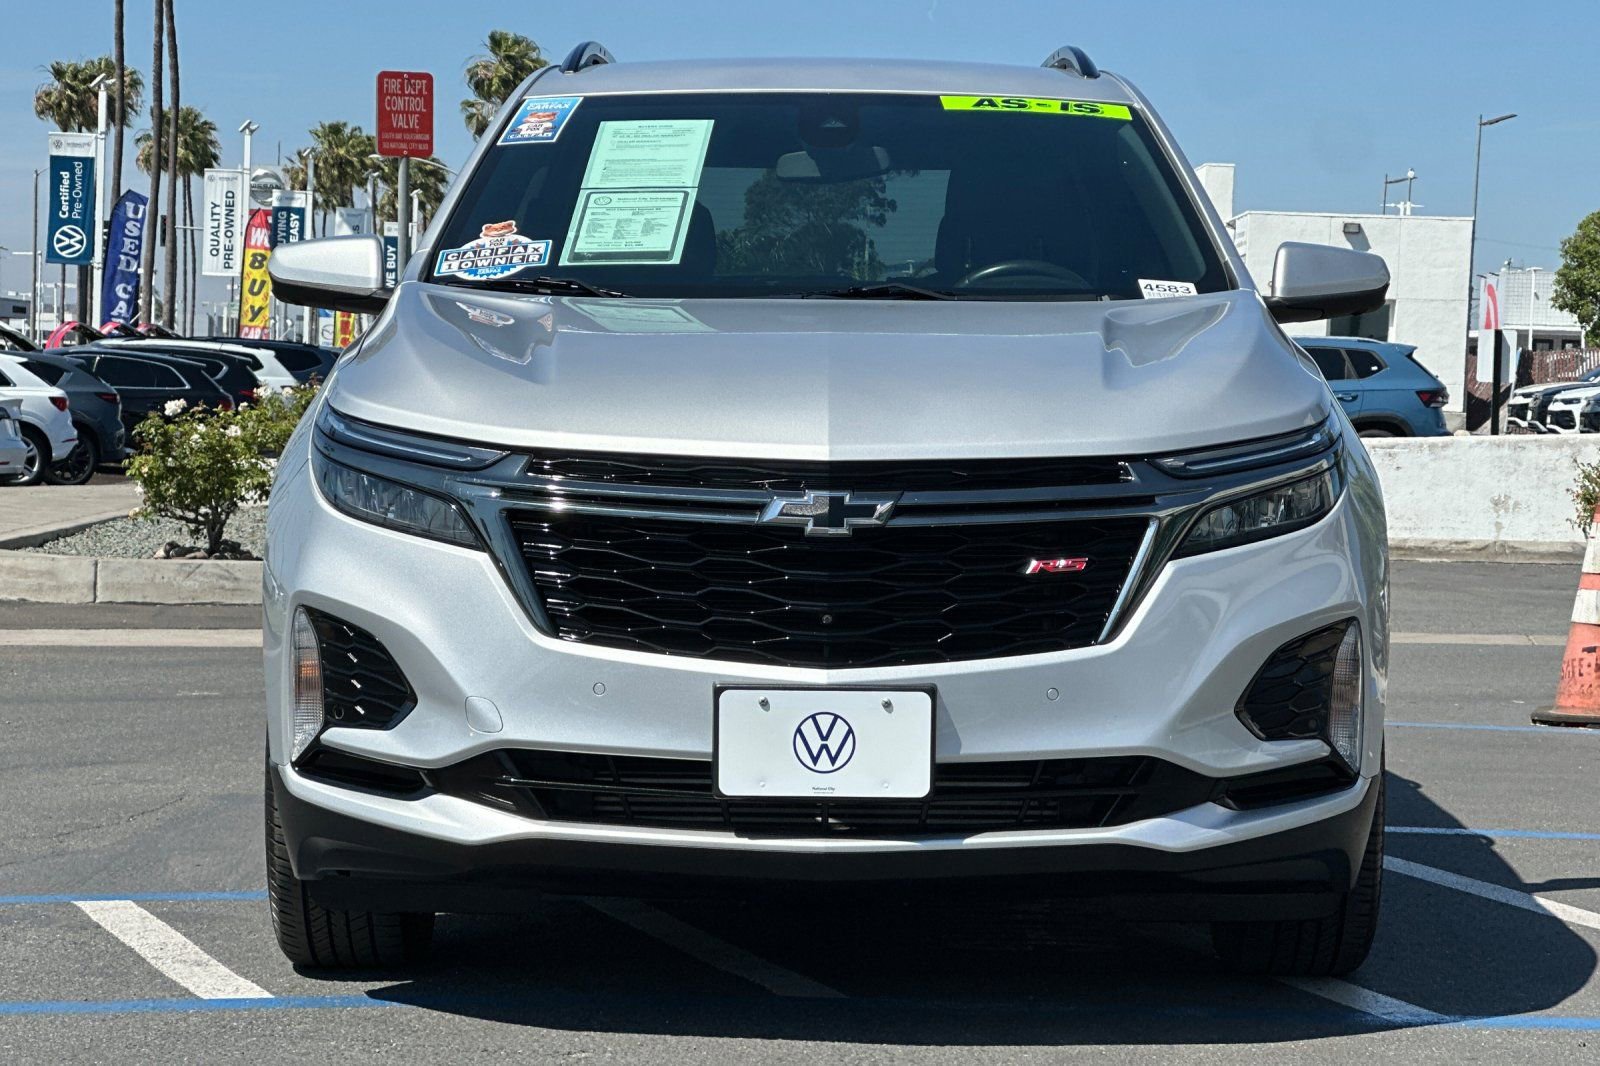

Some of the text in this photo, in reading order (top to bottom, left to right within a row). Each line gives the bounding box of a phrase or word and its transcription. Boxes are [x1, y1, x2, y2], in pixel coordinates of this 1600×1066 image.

[383, 78, 402, 94] FIRE
[384, 96, 427, 112] CONTROL
[391, 113, 420, 129] VALVE
[59, 171, 70, 219] Certified
[71, 161, 83, 219] Pre-Owned
[117, 201, 146, 272] USED
[209, 201, 220, 257] QUALITY
[223, 190, 235, 270] PRE-OWNED
[276, 211, 287, 245] UYING
[289, 212, 300, 243] EASY
[385, 245, 397, 289] WE BUY
[446, 245, 542, 261] CARFAX
[460, 254, 540, 269] OWNER
[248, 252, 268, 322] BUY
[1143, 283, 1192, 294] 4583
[1025, 557, 1088, 574] RS
